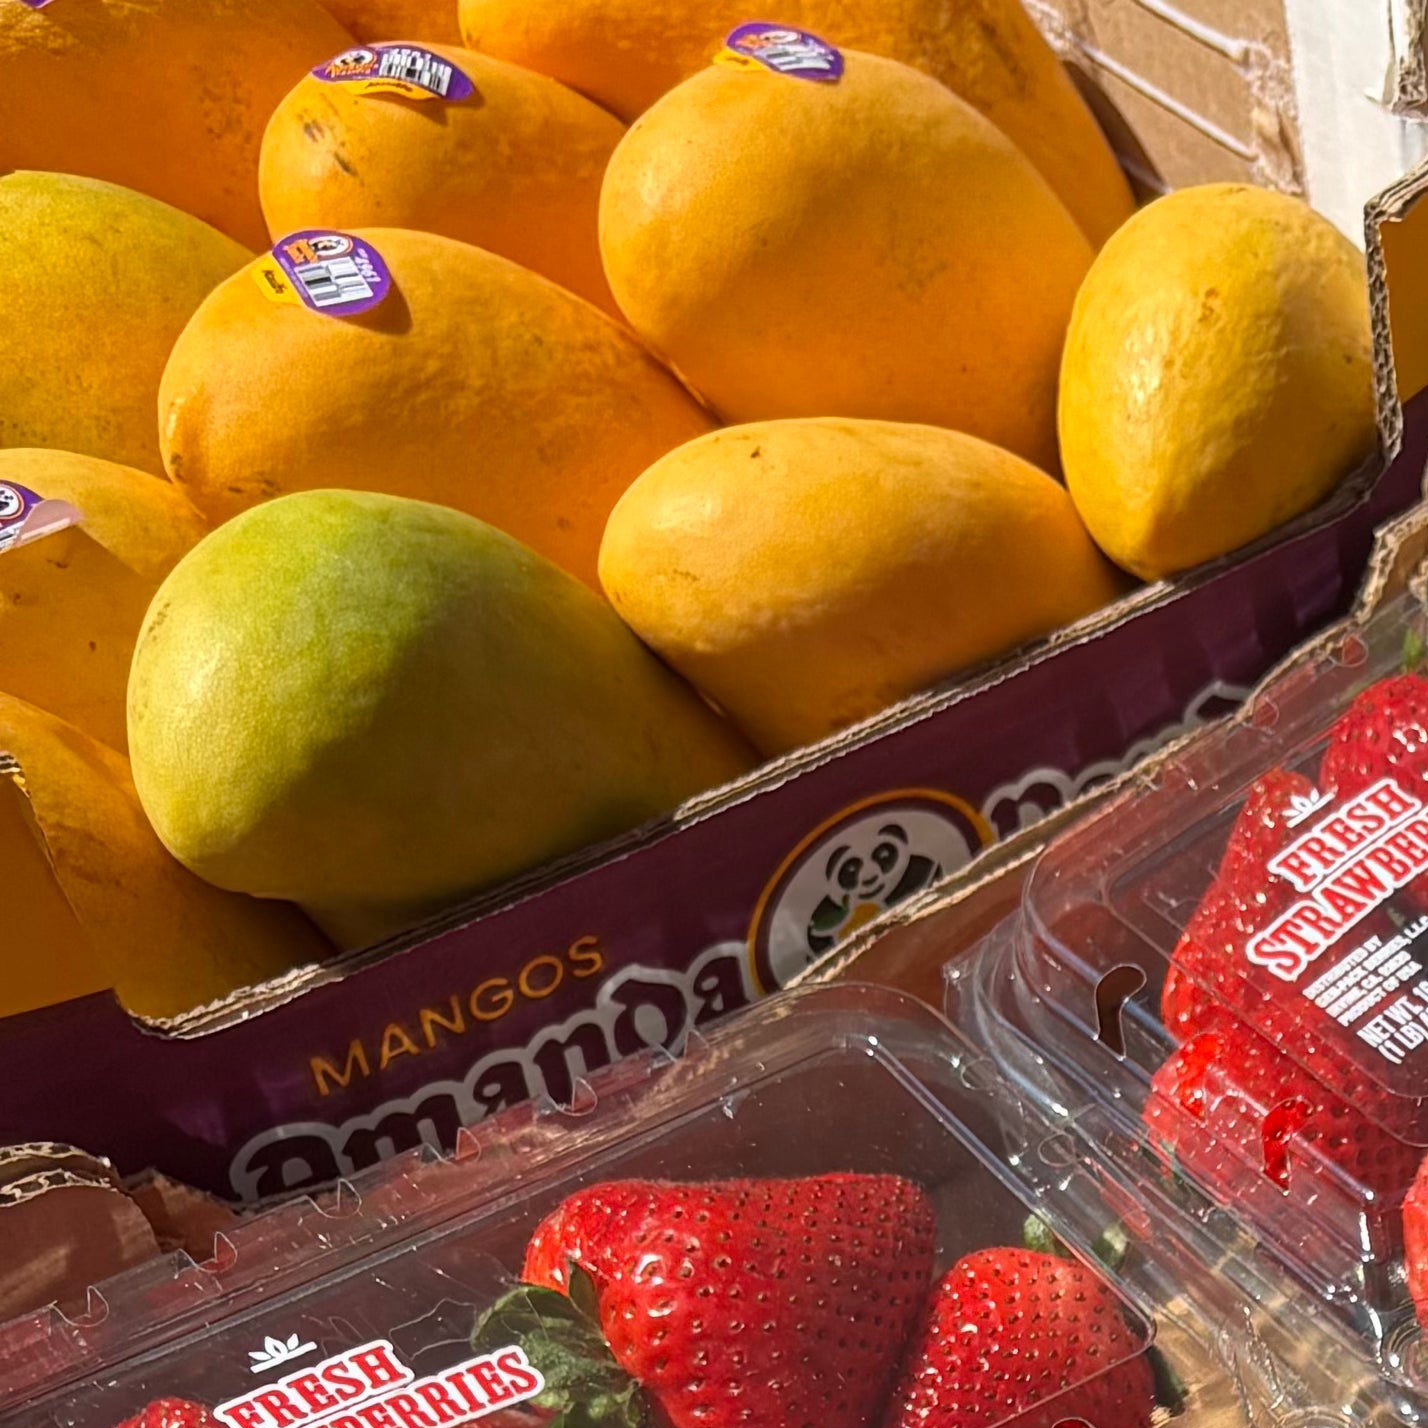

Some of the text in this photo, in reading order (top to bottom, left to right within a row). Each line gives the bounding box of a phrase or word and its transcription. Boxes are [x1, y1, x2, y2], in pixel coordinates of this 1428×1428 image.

[1272, 780, 1416, 887] FRESH
[309, 935, 604, 1097] MANGOS
[1355, 1013, 1397, 1048] NET
